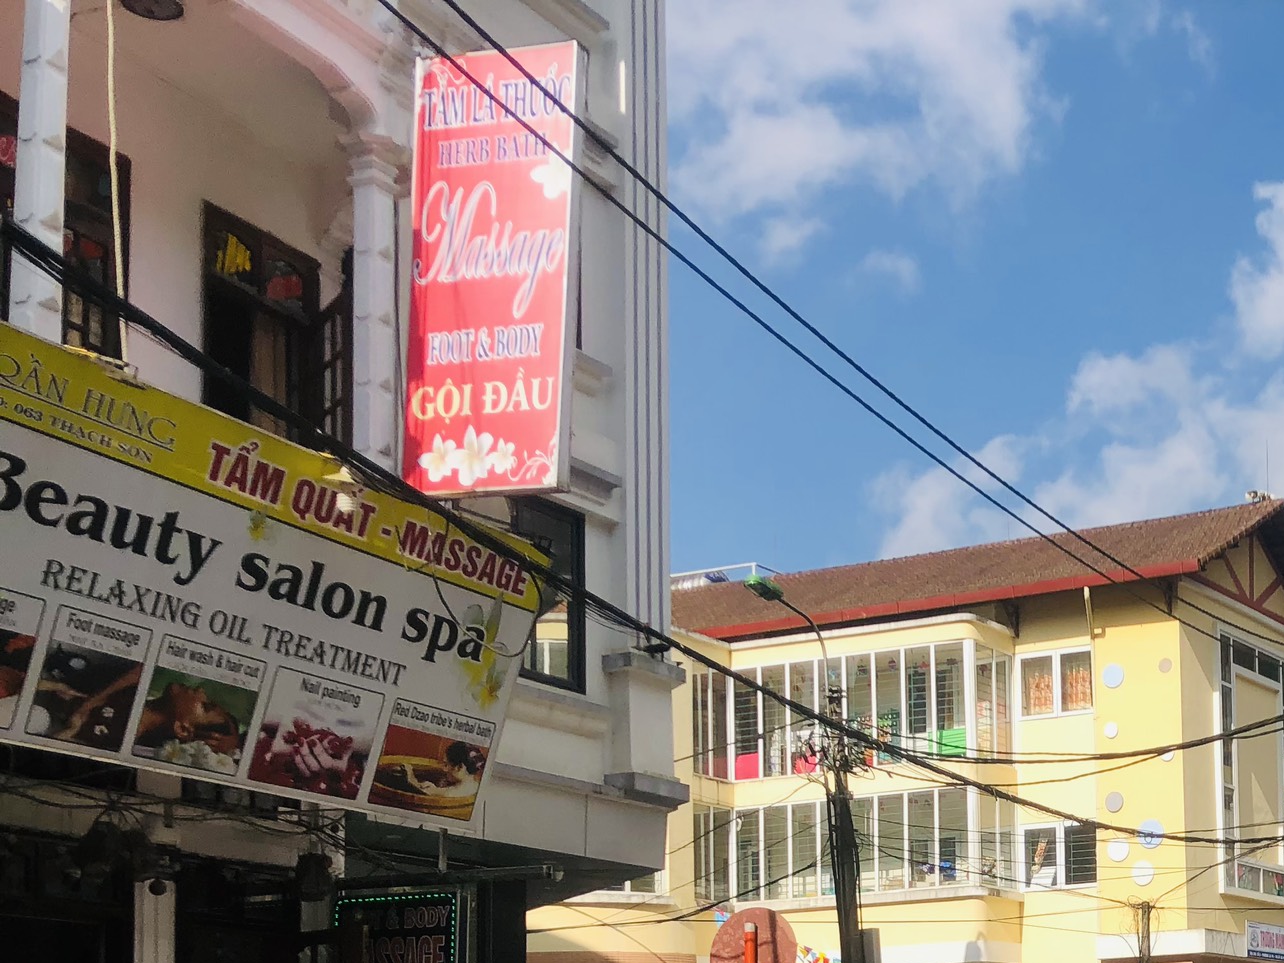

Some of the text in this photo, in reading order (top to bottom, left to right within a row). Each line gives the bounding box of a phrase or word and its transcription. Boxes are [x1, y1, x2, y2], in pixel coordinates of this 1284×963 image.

[438, 131, 550, 168] HERB BATH
[414, 179, 565, 319] Massage
[427, 329, 474, 366] FOOT
[493, 323, 545, 361] BODY
[411, 366, 556, 427] GỘI ĐẦU
[207, 440, 287, 505] TẨM
[398, 519, 528, 597] MASSAGE
[0, 450, 487, 664] Beauty salon spa
[40, 558, 408, 688] RELAXING OIL TREATMENT
[65, 612, 92, 634] Foot
[92, 620, 141, 648] massage
[300, 677, 320, 697] Nail
[320, 685, 362, 709] painting
[394, 701, 411, 718] Red
[410, 706, 431, 723] Dzao
[453, 718, 476, 736] herbal
[475, 723, 492, 740] bath
[403, 905, 451, 929] BODY
